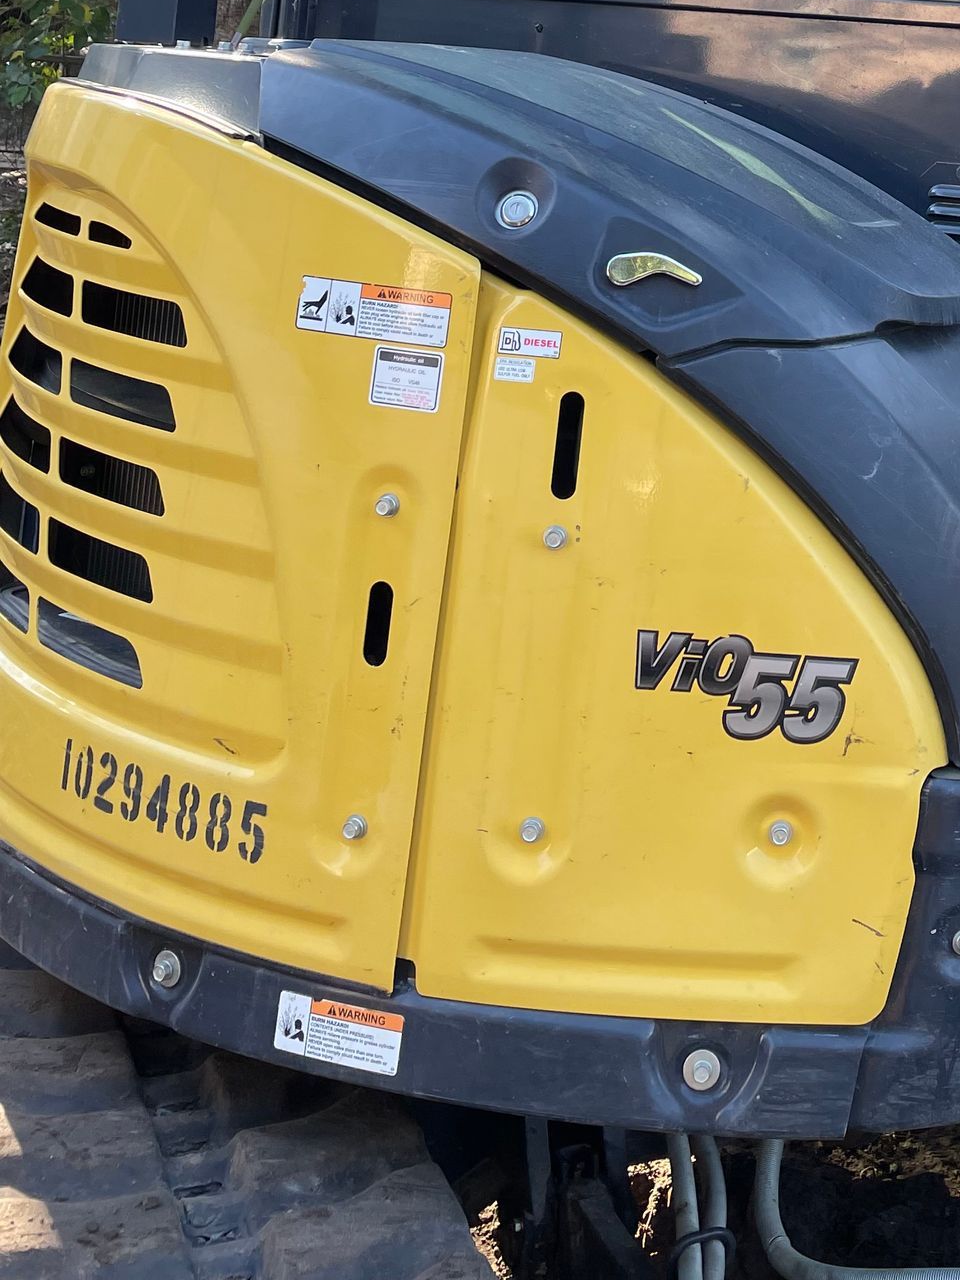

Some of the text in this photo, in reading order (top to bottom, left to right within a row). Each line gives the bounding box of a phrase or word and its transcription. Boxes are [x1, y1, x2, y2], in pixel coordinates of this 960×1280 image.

[388, 290, 433, 303] WARNING
[524, 338, 558, 348] DIESEL
[394, 355, 416, 364] Hydraulic
[60, 738, 268, 864] 10294885
[338, 1007, 386, 1026] WARNING
